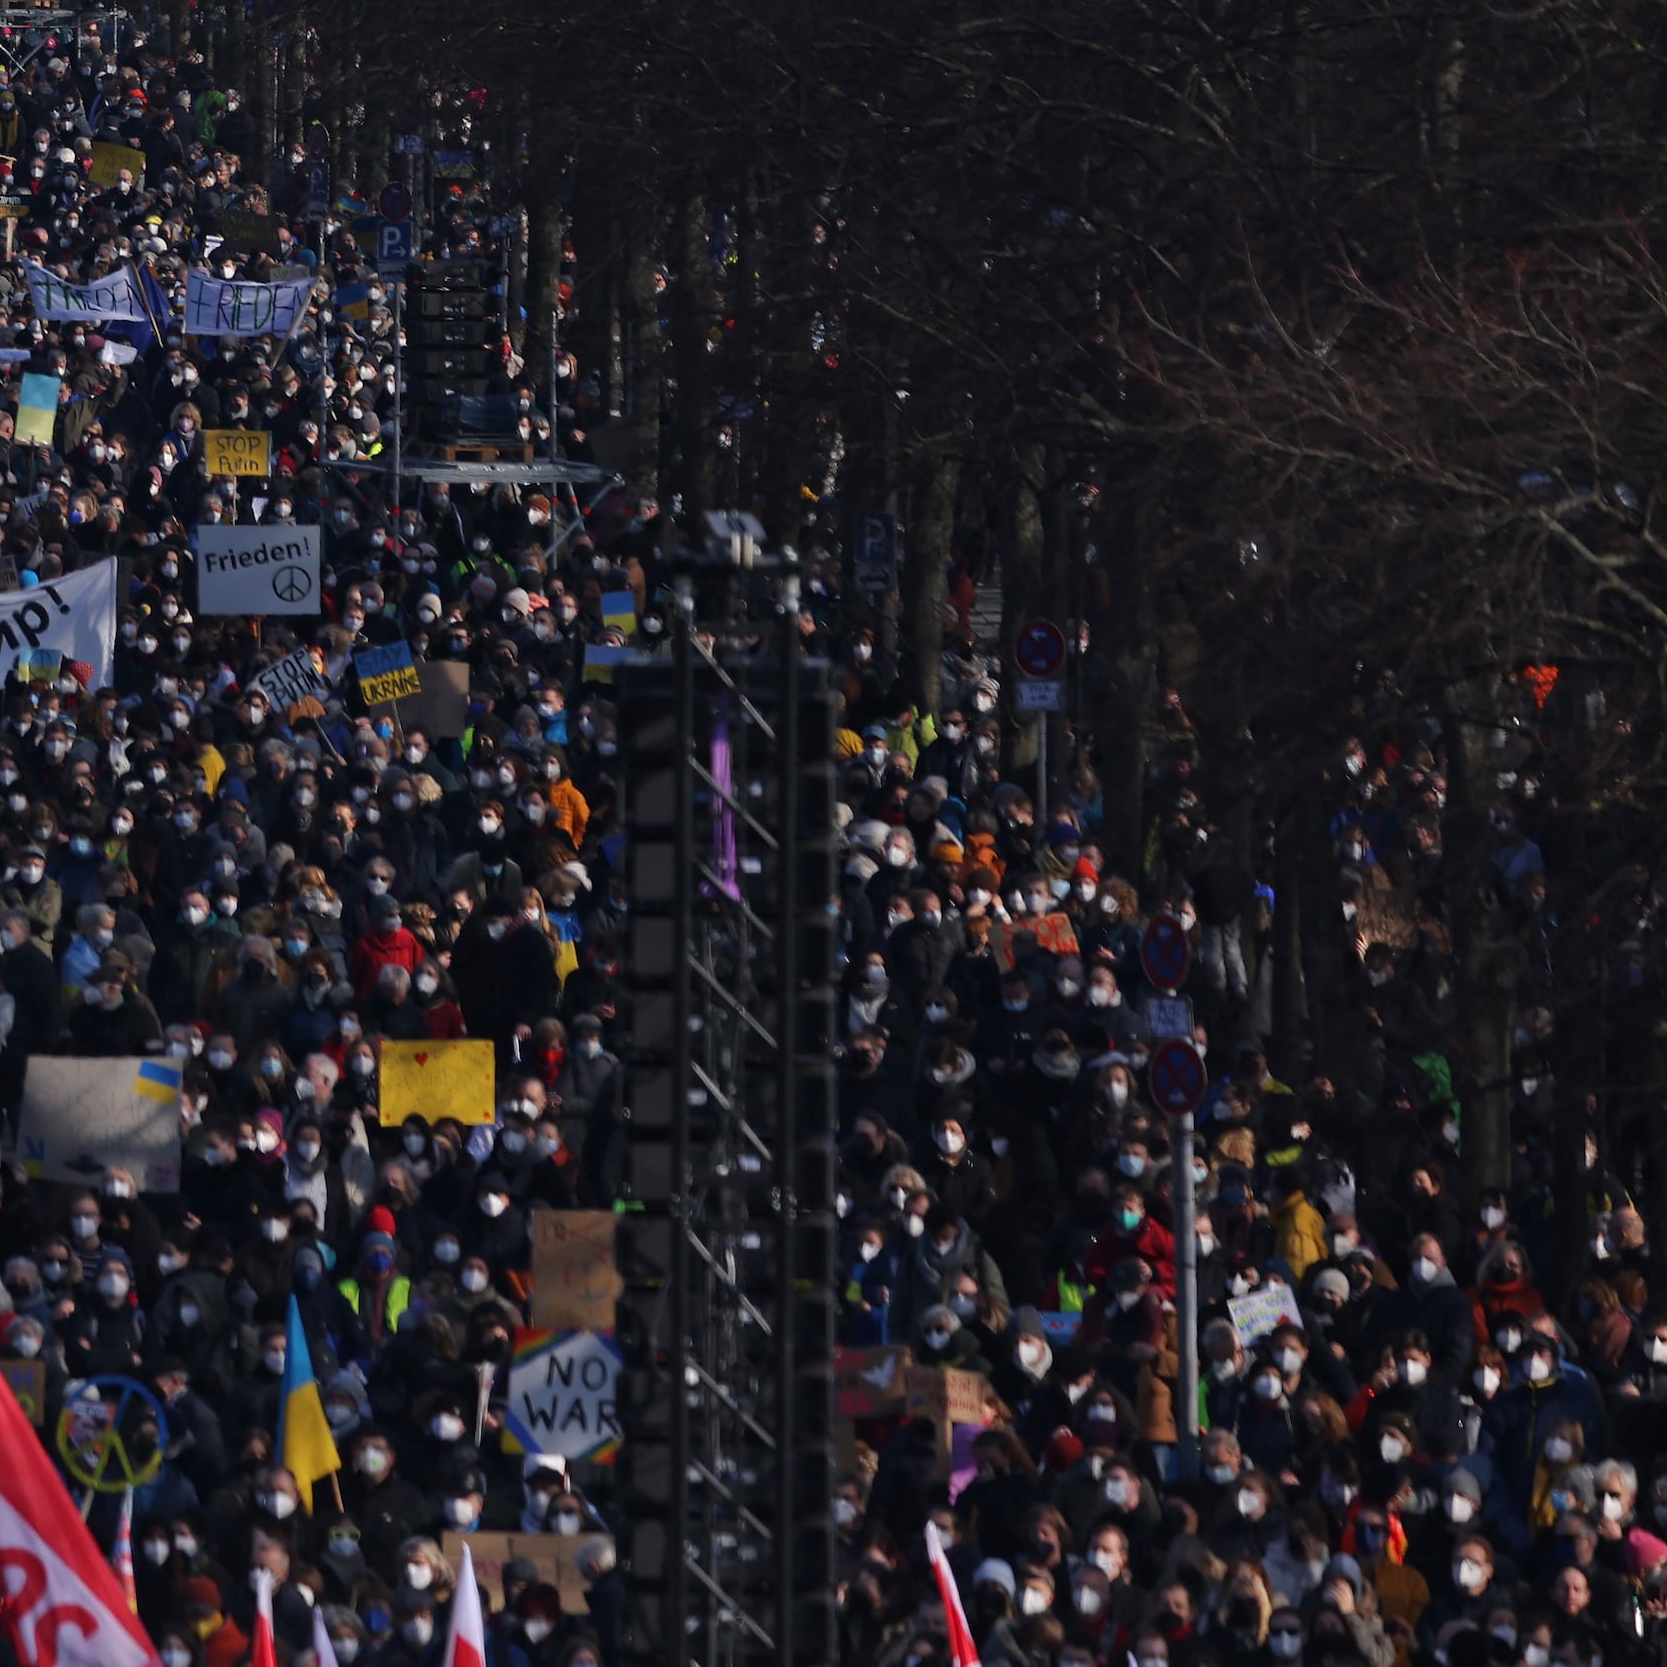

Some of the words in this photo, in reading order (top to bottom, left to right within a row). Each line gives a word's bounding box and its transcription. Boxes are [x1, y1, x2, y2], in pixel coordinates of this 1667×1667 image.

[383, 227, 400, 256] P
[216, 435, 261, 453] STOP
[218, 455, 259, 472] Putin
[205, 536, 311, 574] Frieden!
[259, 650, 307, 690] STOP
[272, 665, 325, 709] PUTIN
[361, 675, 421, 703] UKRAINE
[548, 1353, 609, 1390] NO
[524, 1391, 623, 1436] WAR
